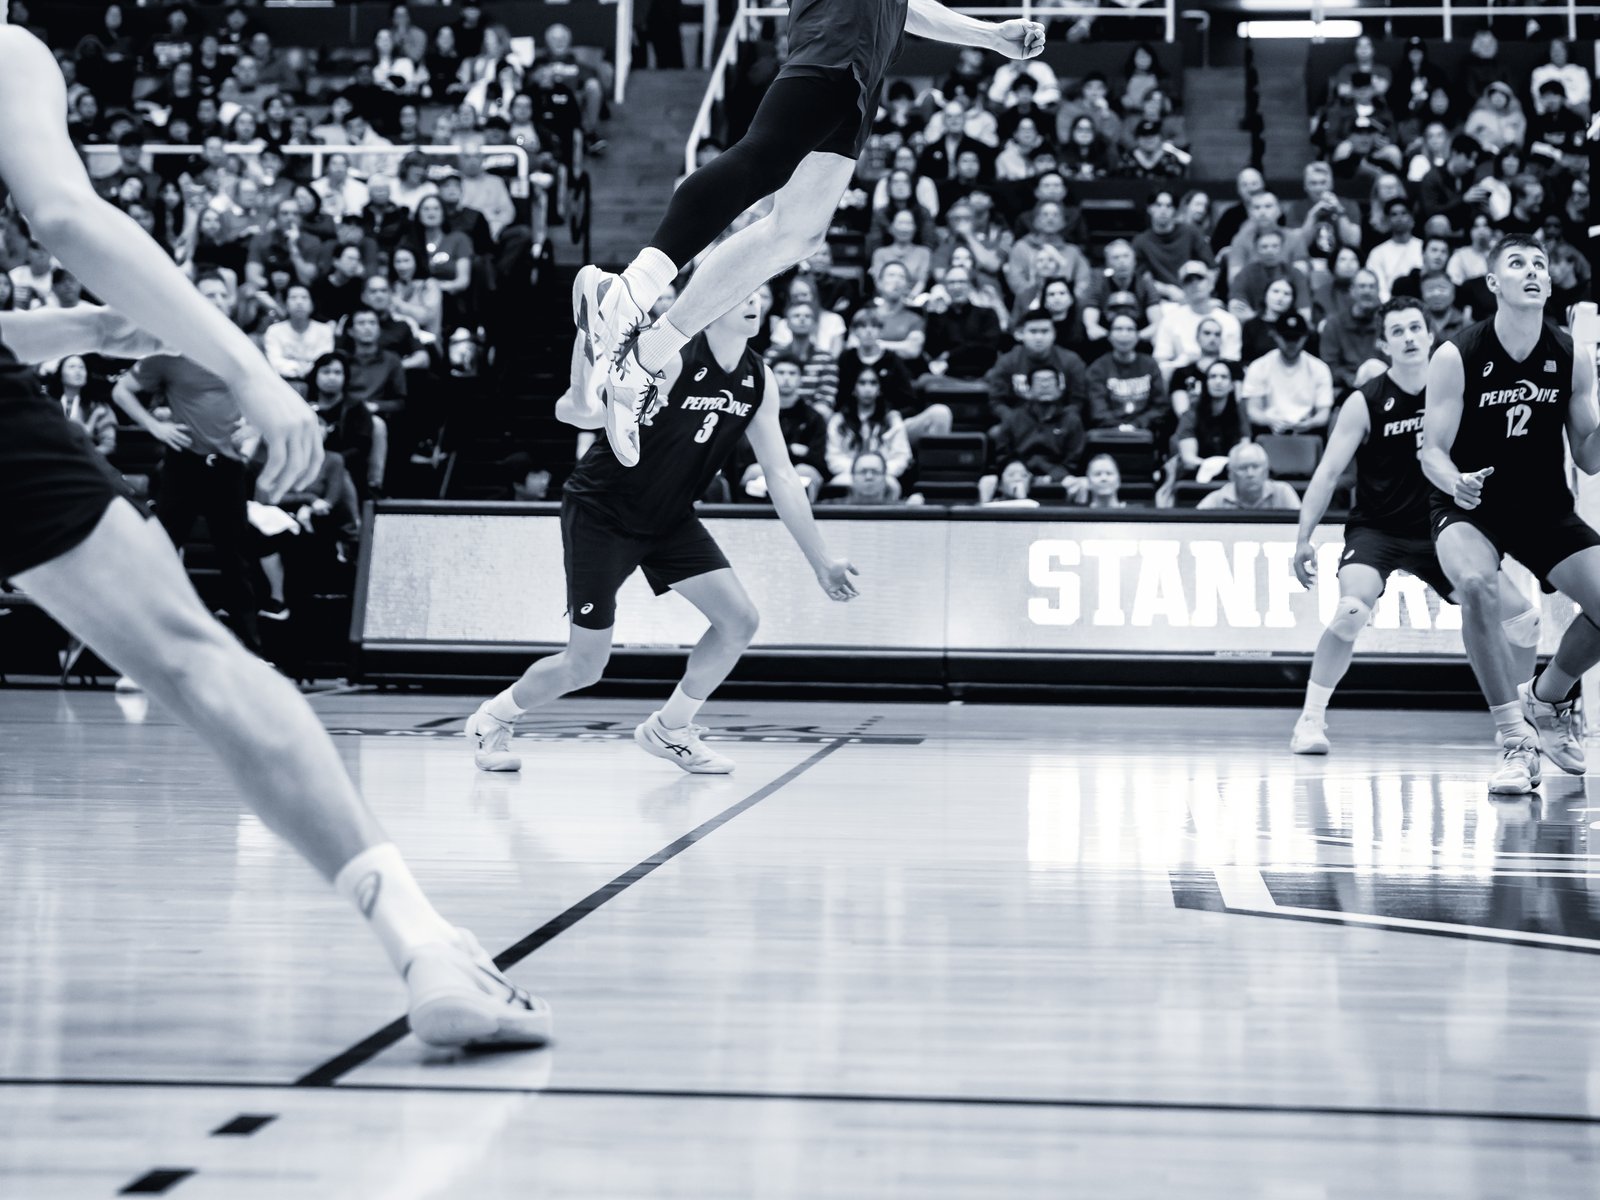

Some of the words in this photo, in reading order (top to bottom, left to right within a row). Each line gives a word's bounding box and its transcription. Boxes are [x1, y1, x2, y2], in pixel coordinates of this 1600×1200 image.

[680, 389, 752, 417] PEPPERDINE
[1478, 379, 1560, 408] PEPPERDINE
[694, 412, 719, 444] 3
[1506, 403, 1532, 438] 12
[1027, 540, 1462, 630] STANFR
